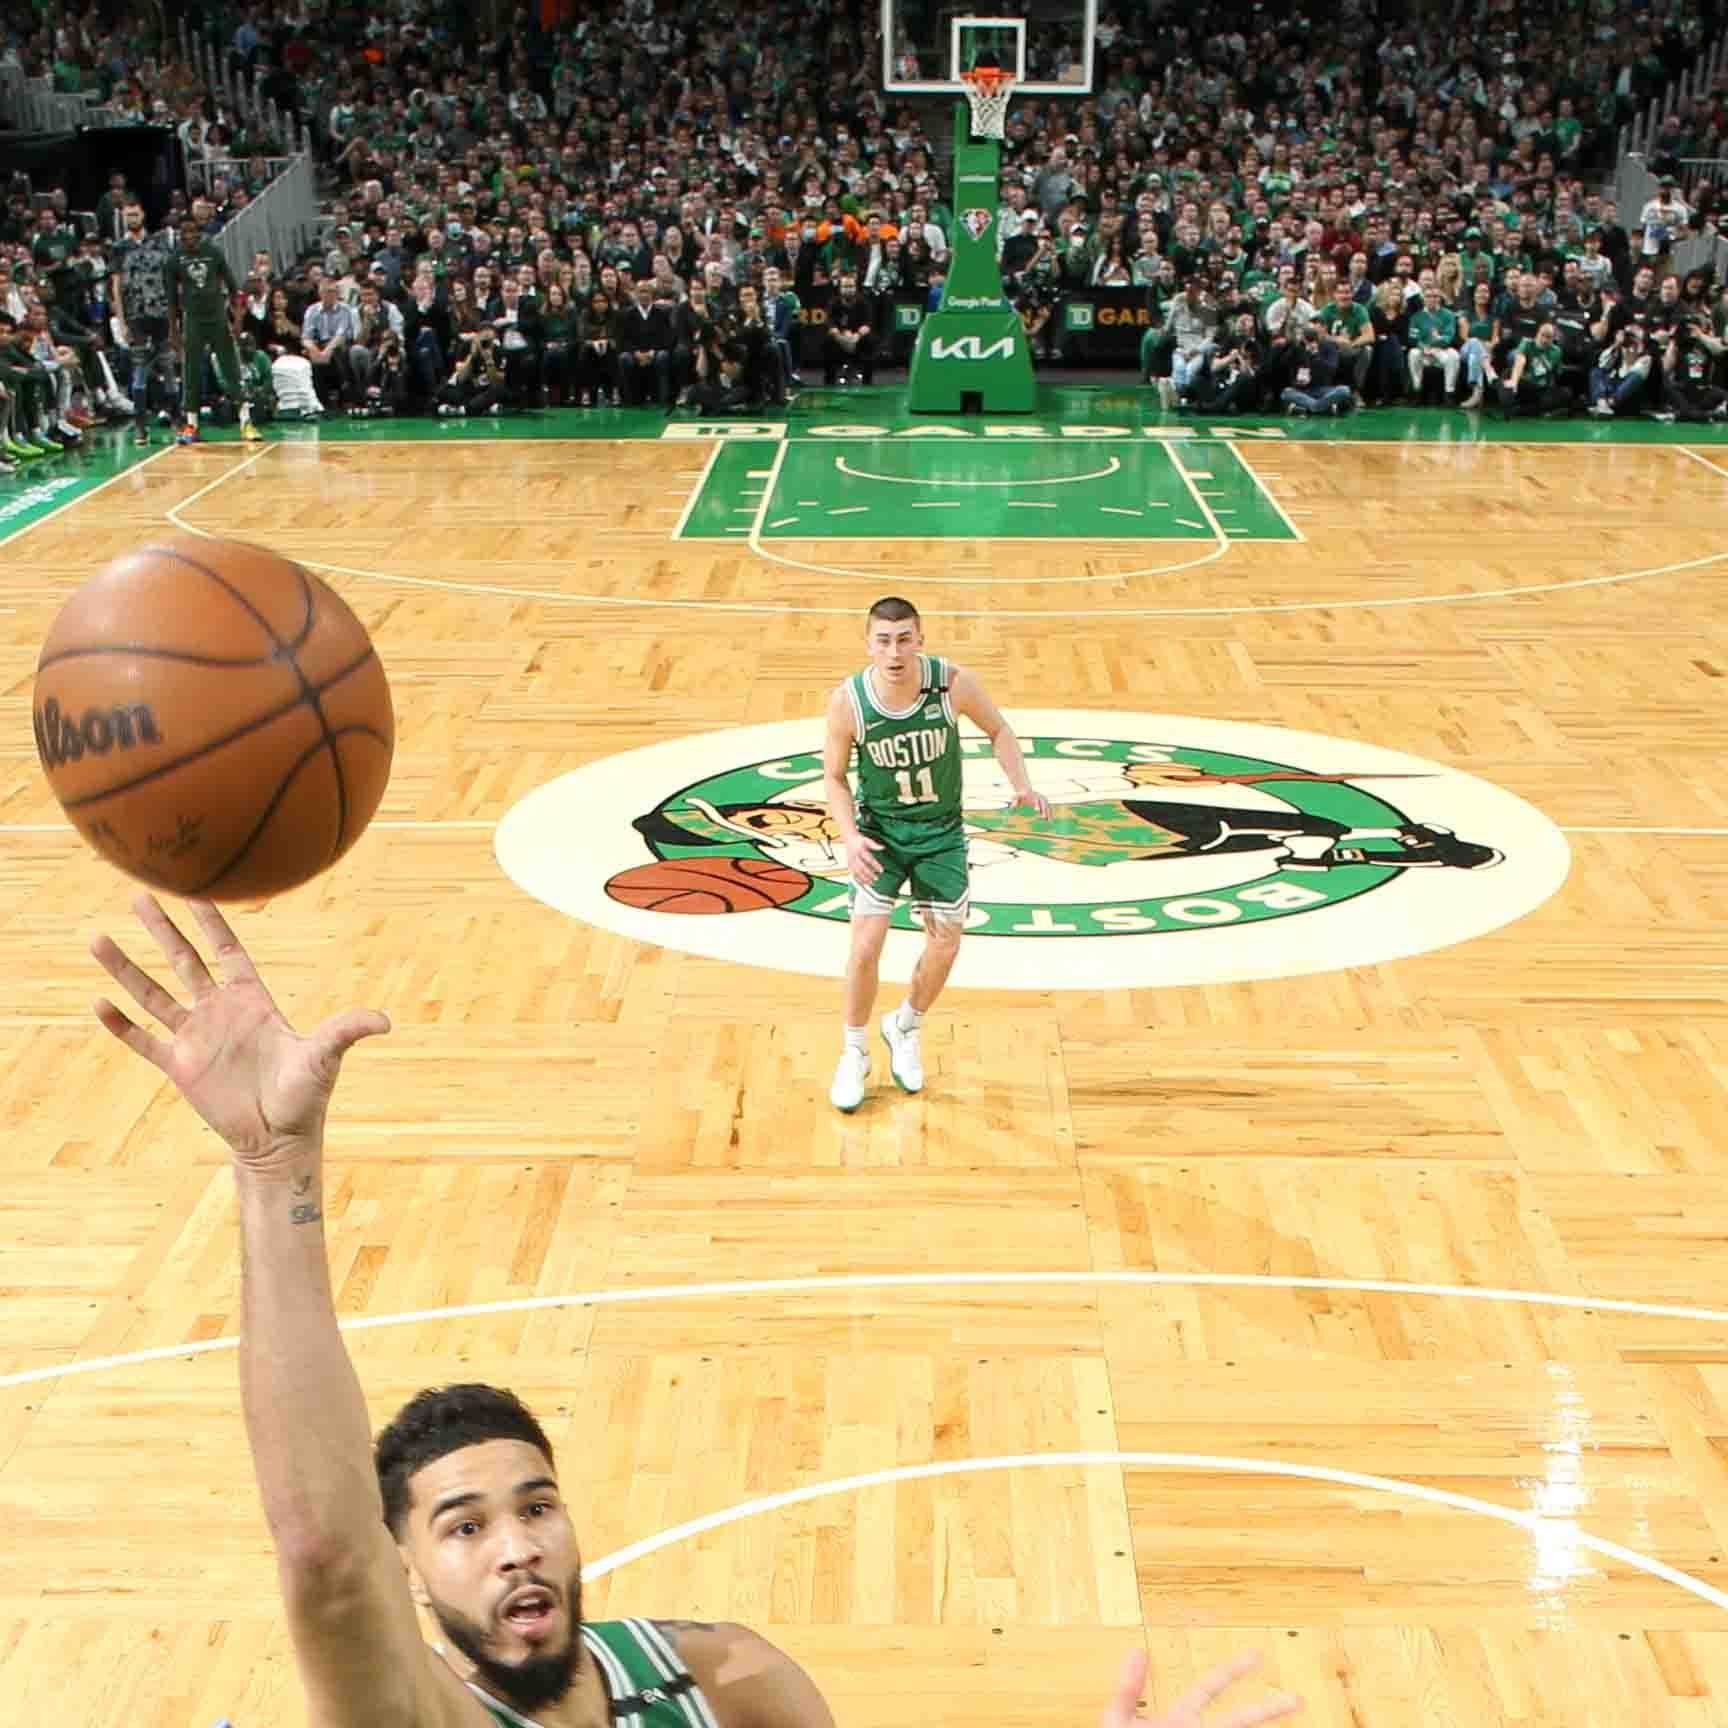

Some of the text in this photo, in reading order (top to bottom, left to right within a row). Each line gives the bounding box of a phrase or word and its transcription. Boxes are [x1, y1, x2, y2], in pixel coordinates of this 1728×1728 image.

[930, 335, 1015, 360] KIA
[806, 424, 1288, 439] GARDEN
[757, 737, 1178, 780] CTICS
[866, 727, 948, 769] BOSTON
[895, 766, 939, 805] 11
